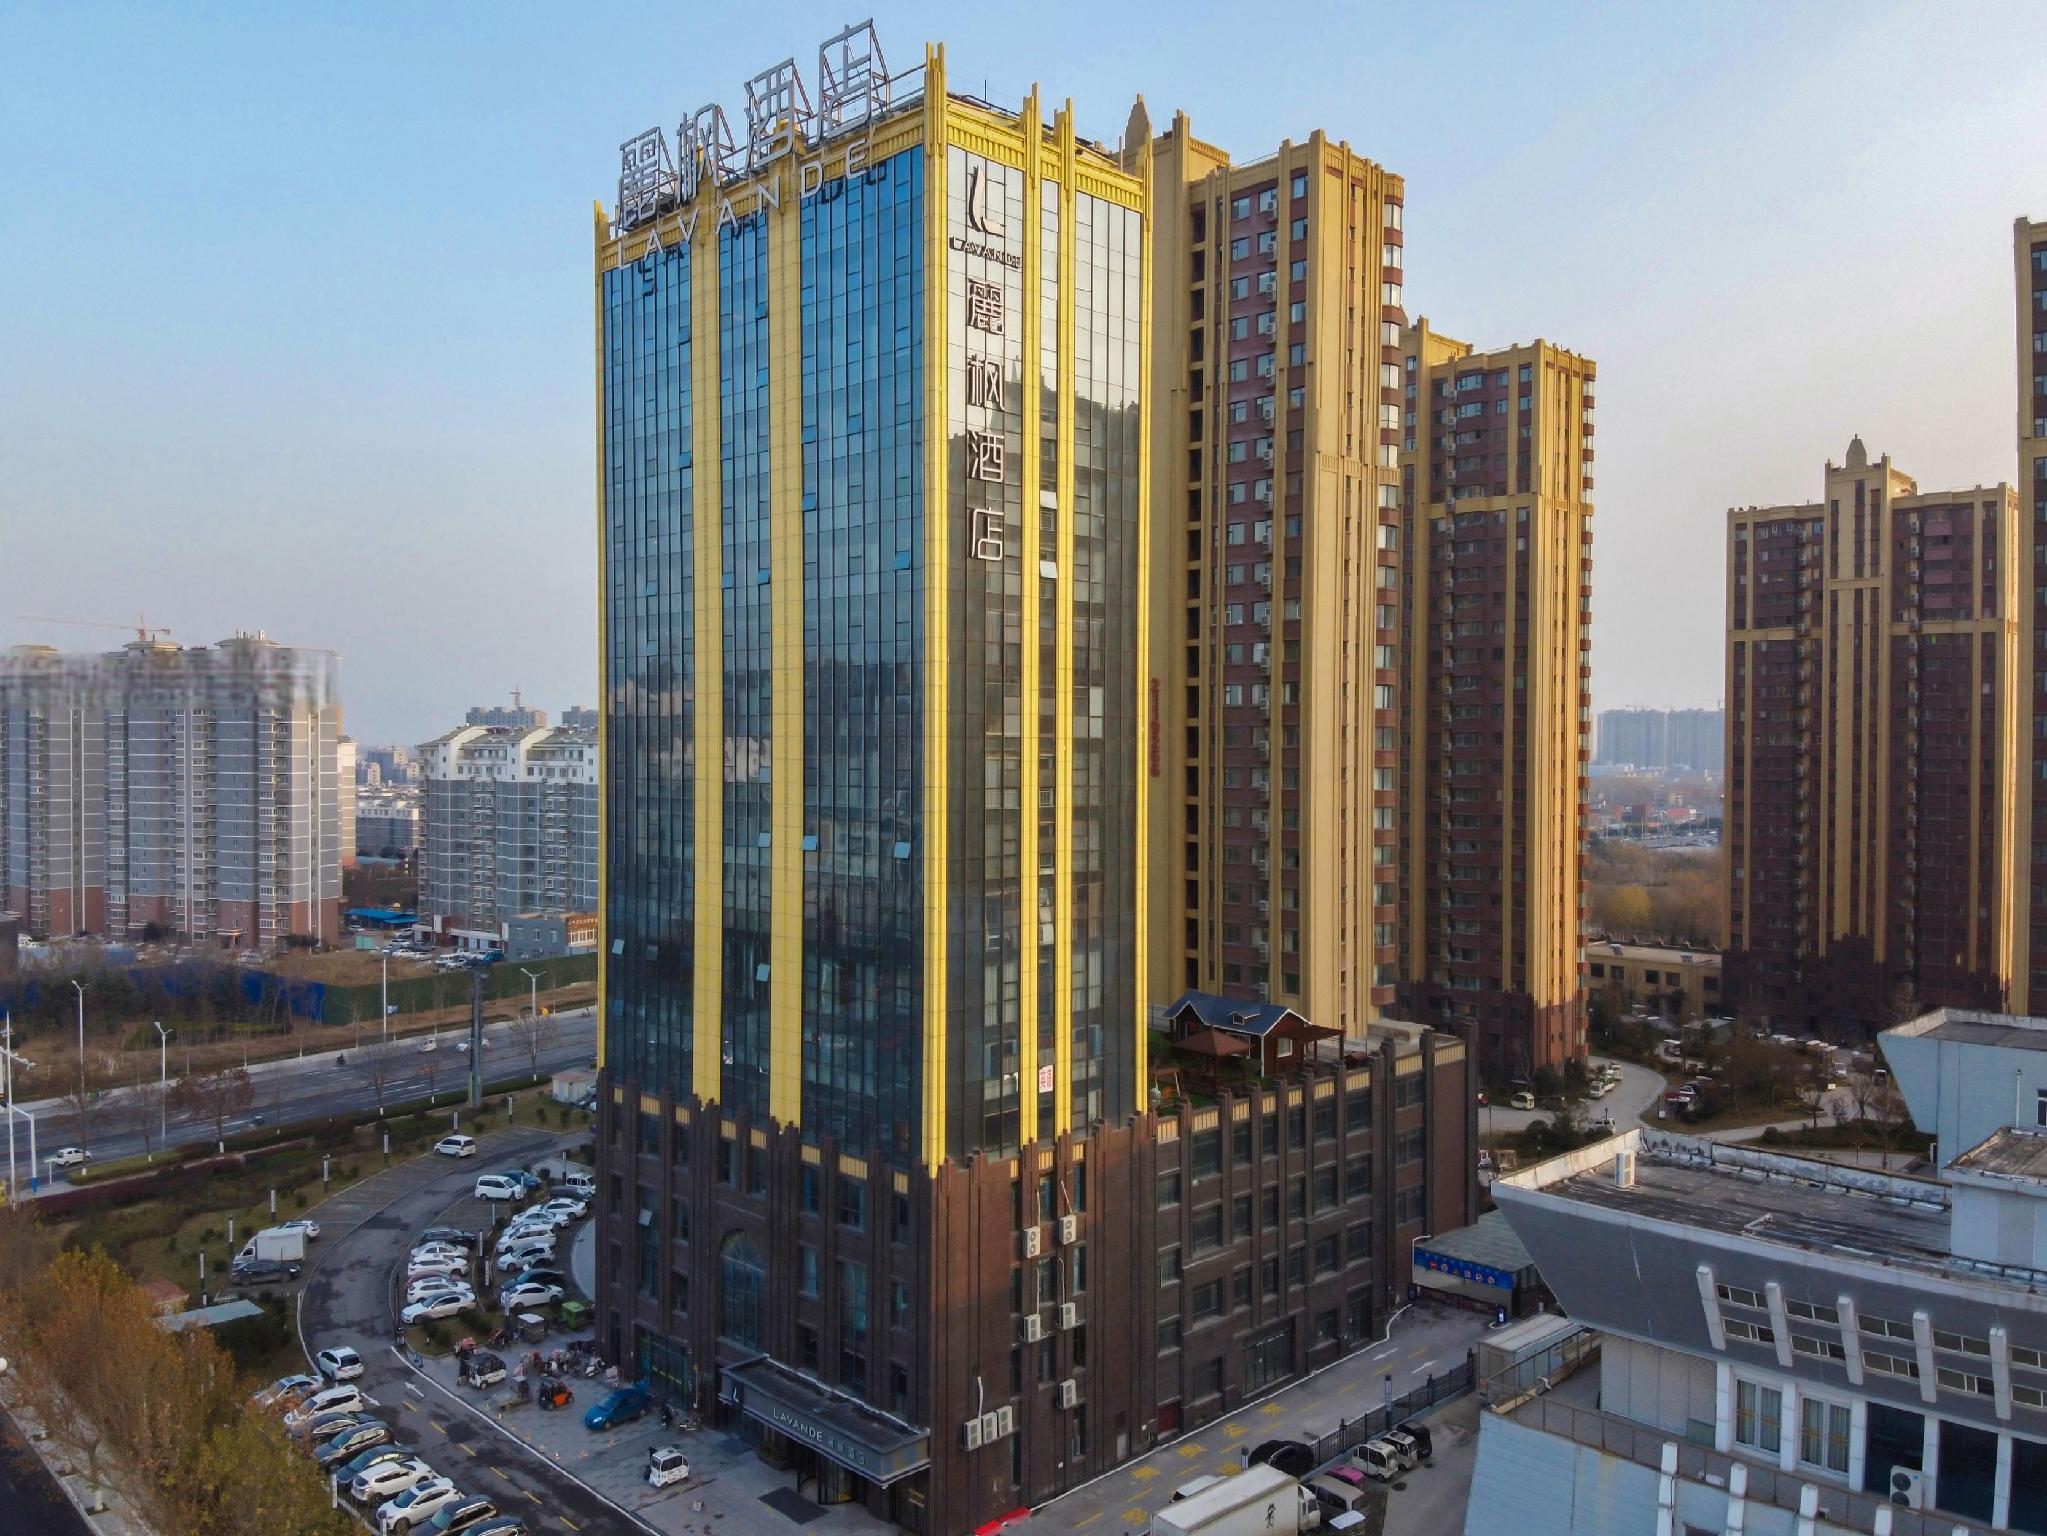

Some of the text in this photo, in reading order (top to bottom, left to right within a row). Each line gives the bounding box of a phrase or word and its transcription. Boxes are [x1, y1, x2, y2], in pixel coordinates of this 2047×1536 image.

[617, 138, 868, 270] LAVANDE
[950, 236, 1021, 268] LAVANDE
[773, 1408, 823, 1442] LAVANDE
